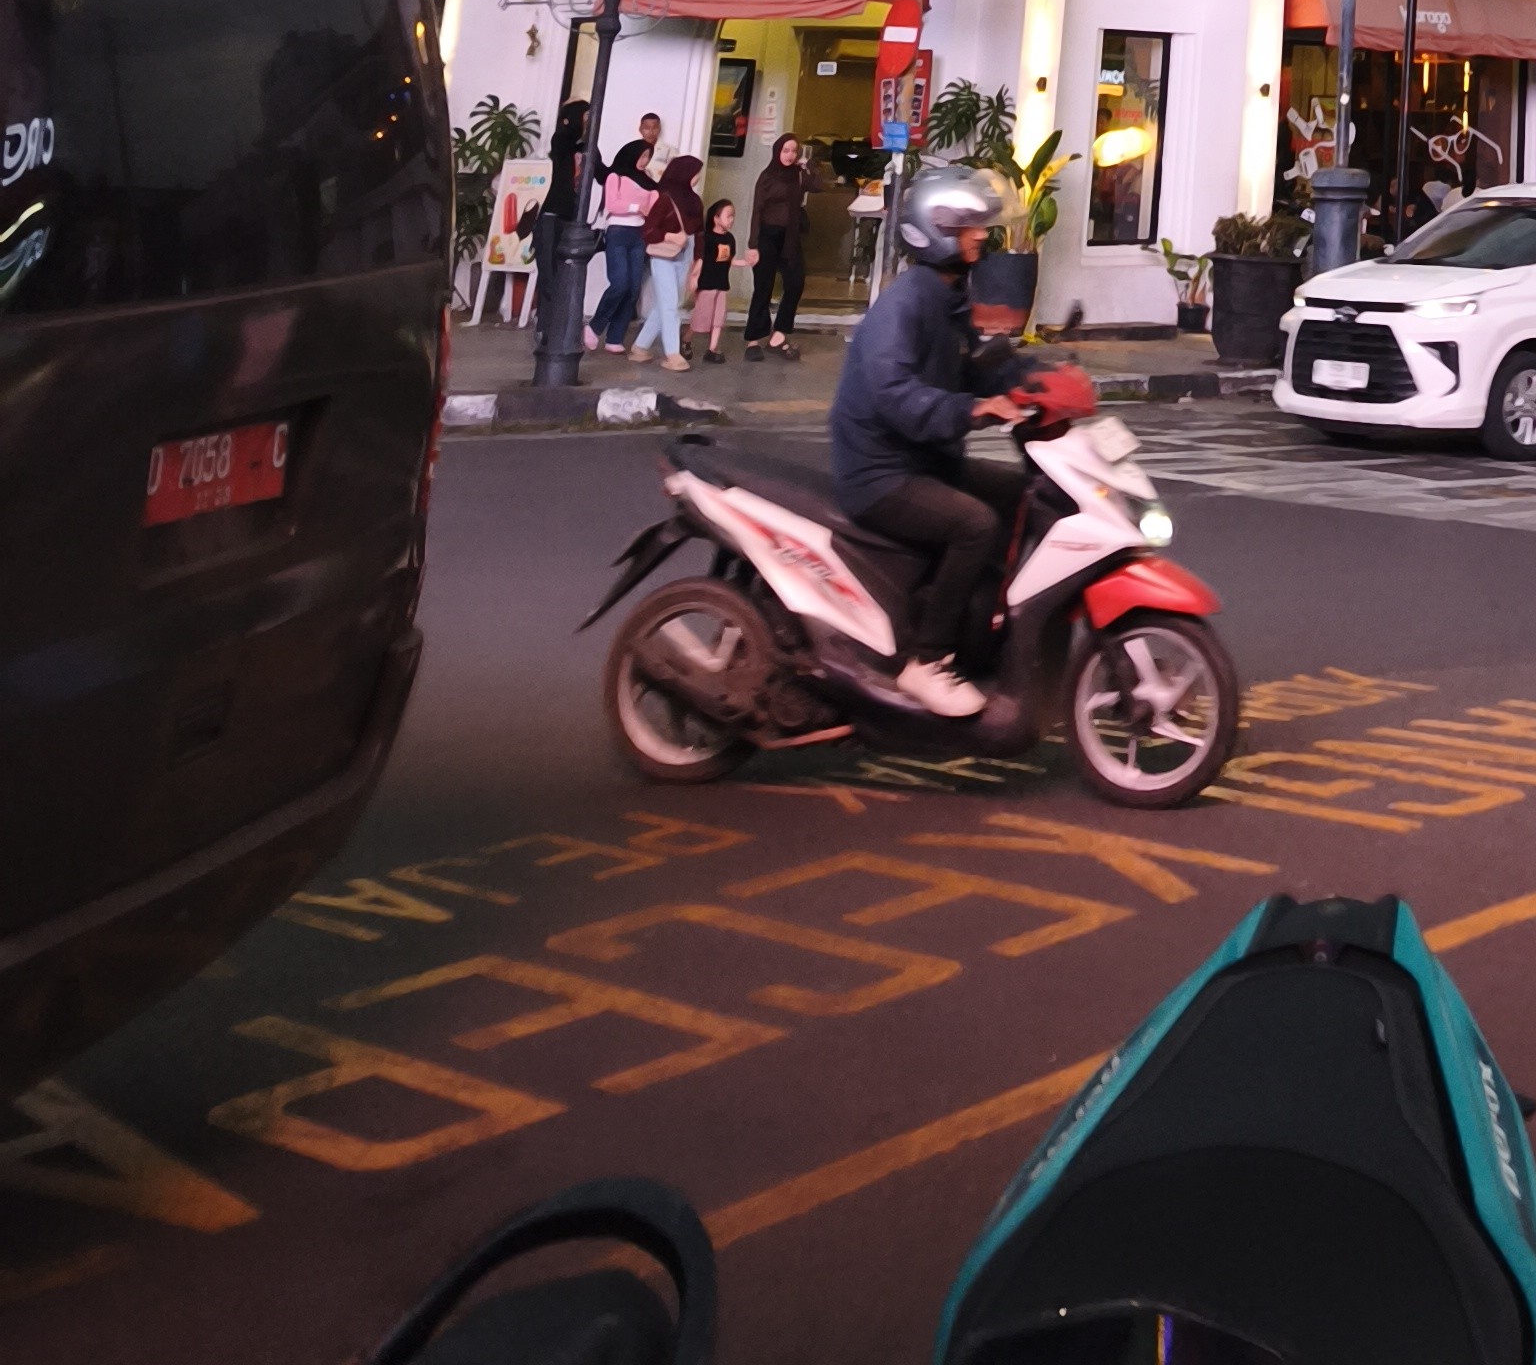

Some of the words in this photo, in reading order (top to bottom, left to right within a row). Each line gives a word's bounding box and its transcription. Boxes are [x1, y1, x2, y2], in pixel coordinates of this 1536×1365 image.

[146, 445, 165, 496] D
[272, 422, 290, 469] C
[0, 812, 1280, 1284] KECEPA
